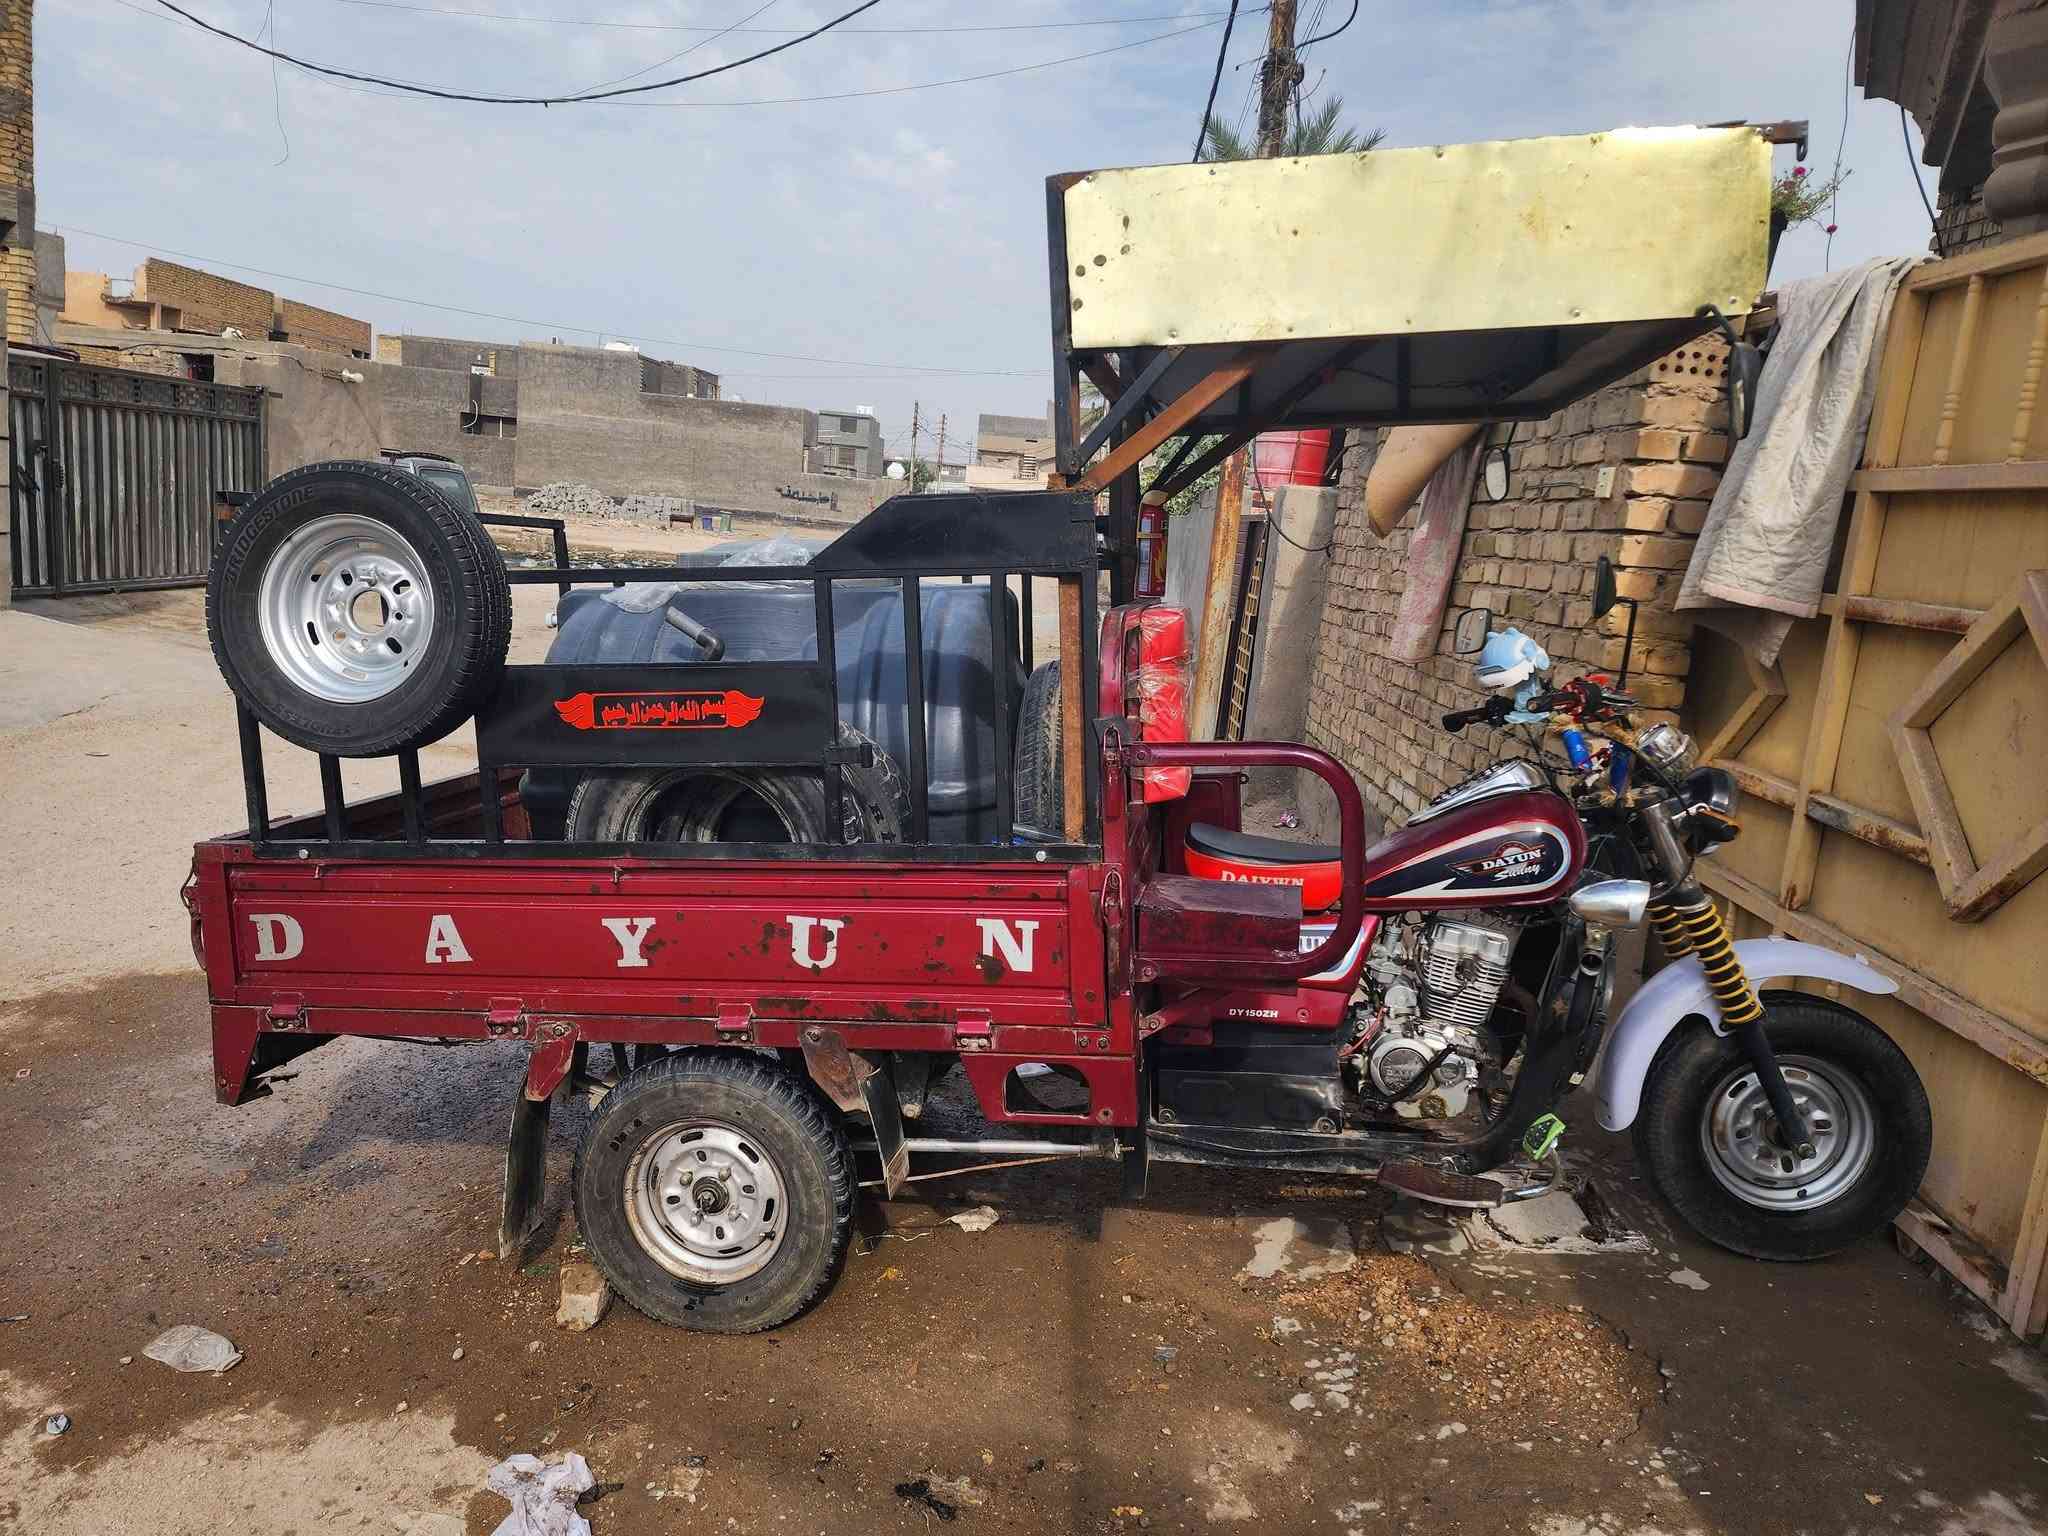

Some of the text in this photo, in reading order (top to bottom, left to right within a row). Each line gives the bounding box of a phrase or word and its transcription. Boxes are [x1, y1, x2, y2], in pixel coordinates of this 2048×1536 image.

[225, 486, 315, 584] BRIDGESTONE
[602, 699, 727, 729] بسم الله الرحمن الرحيم
[1482, 849, 1542, 871] DAYUN
[249, 913, 1040, 972] DAYUN
[1229, 1008, 1279, 1018] DY150ZH
